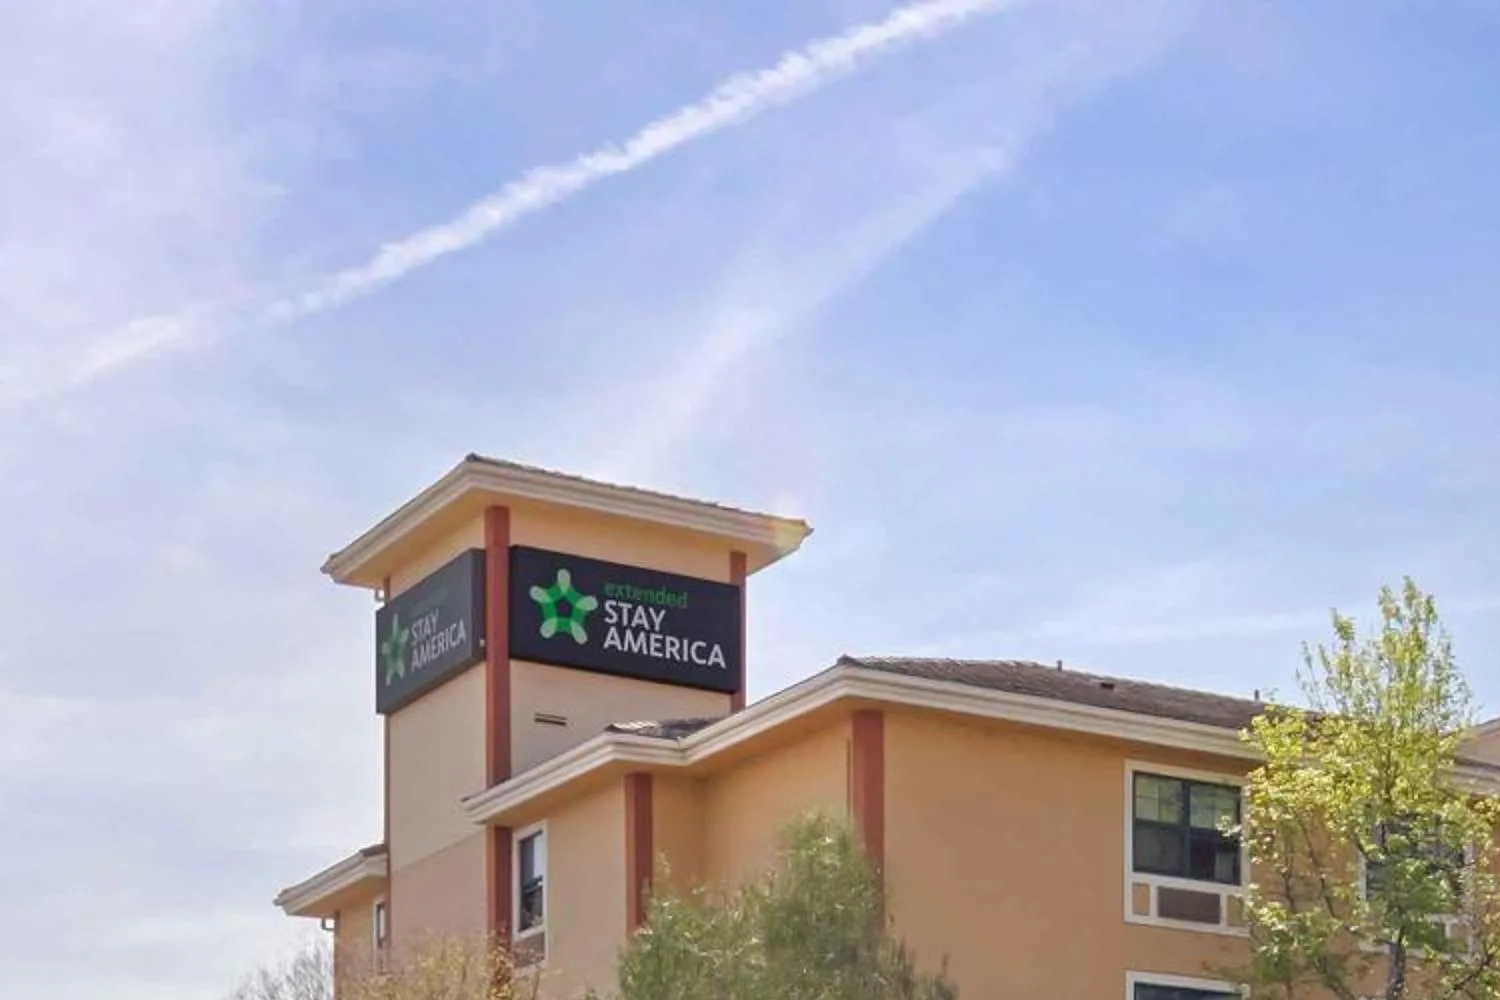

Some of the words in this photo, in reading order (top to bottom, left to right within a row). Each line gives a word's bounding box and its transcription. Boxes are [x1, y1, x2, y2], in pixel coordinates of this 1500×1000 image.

[604, 581, 688, 609] extended
[411, 607, 439, 646] STAY
[603, 600, 666, 631] STAY
[411, 618, 466, 673] AMERICA
[603, 631, 727, 669] AMERICA
